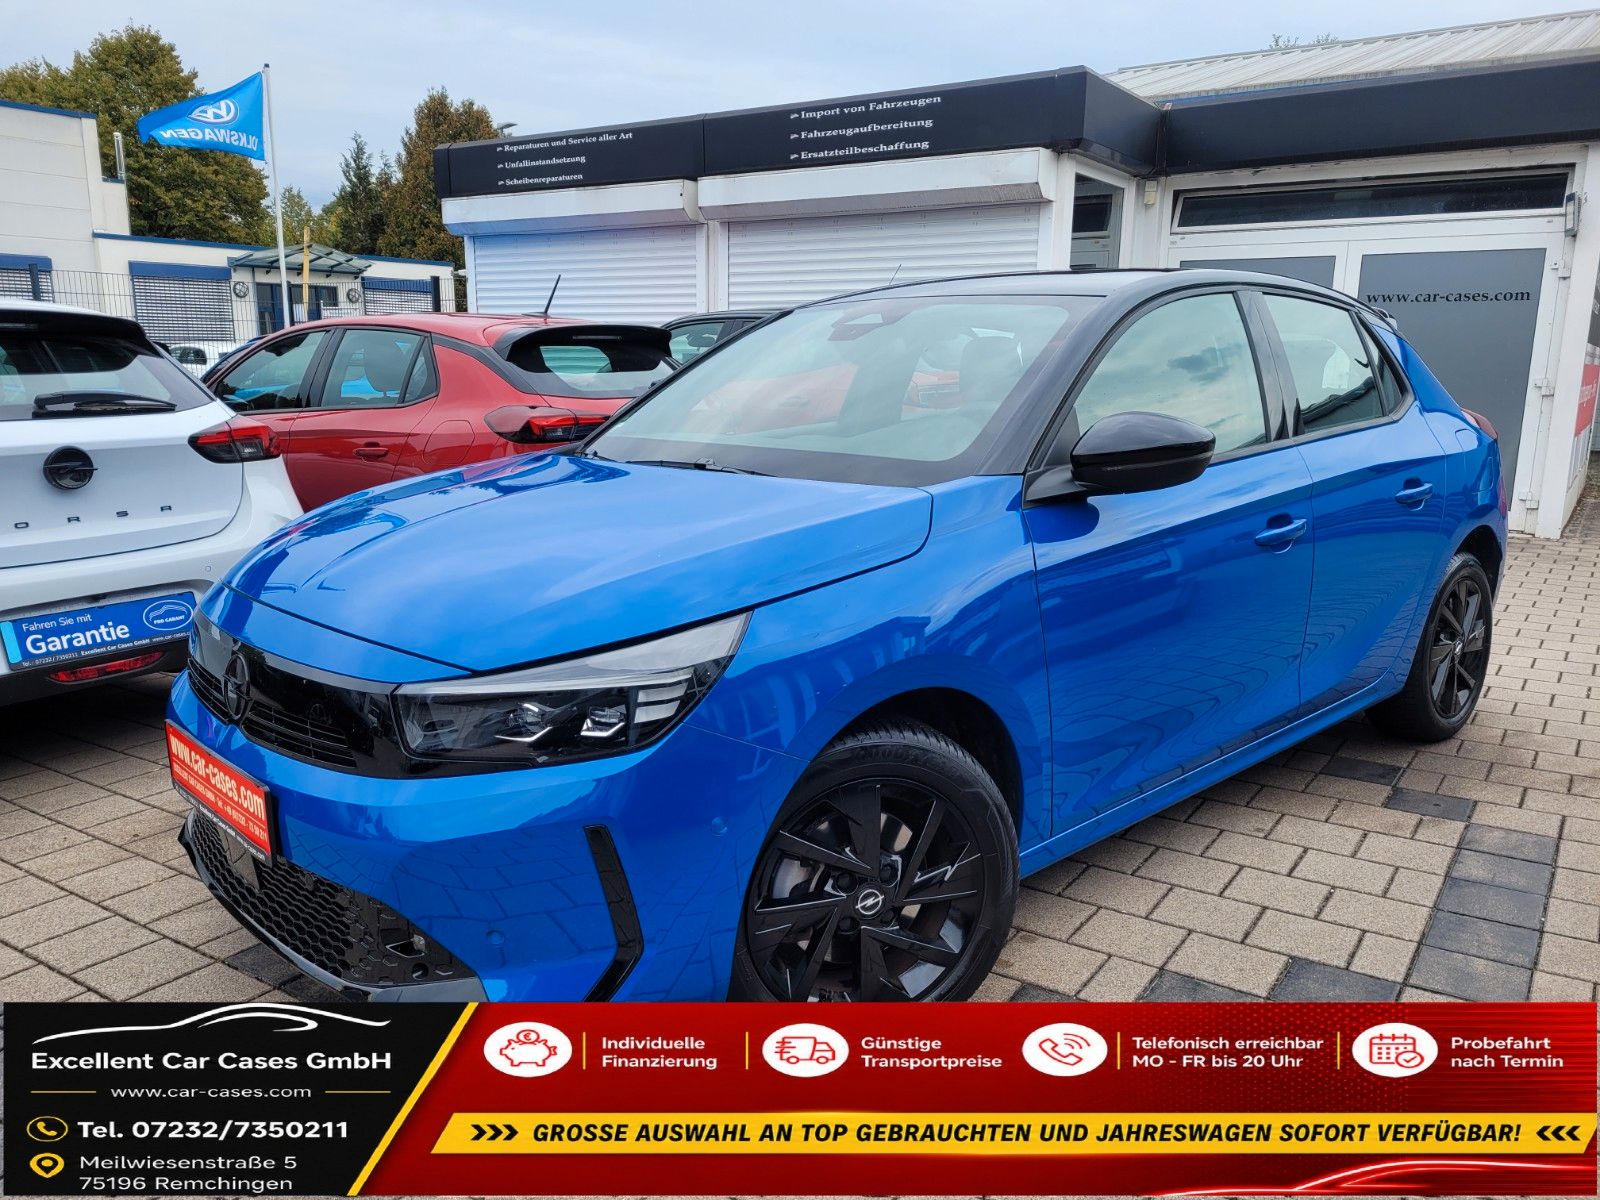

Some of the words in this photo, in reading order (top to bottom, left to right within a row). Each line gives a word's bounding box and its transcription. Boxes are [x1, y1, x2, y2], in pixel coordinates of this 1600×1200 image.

[801, 108, 840, 119] Import
[843, 105, 866, 113] von
[869, 96, 941, 111] Fahrzeugen
[800, 119, 934, 139] Fahrzeugaufbereitung
[504, 141, 550, 153] Reparaturen
[551, 138, 567, 147] und
[568, 136, 597, 145] Service
[598, 133, 617, 142] aller
[619, 132, 633, 140] Art
[800, 140, 930, 159] Ersatzteilbeschaffung
[505, 155, 586, 169] Unfallinstandsetzung
[505, 174, 583, 186] Scheibenreparaturen
[1366, 291, 1531, 304] www.car-cases.com
[14, 505, 172, 529] ORSA
[22, 617, 57, 633] Fahren
[59, 616, 75, 626] Sie
[76, 614, 92, 623] mit
[26, 621, 130, 654] Garantie
[169, 733, 265, 820] www.car-cases.com
